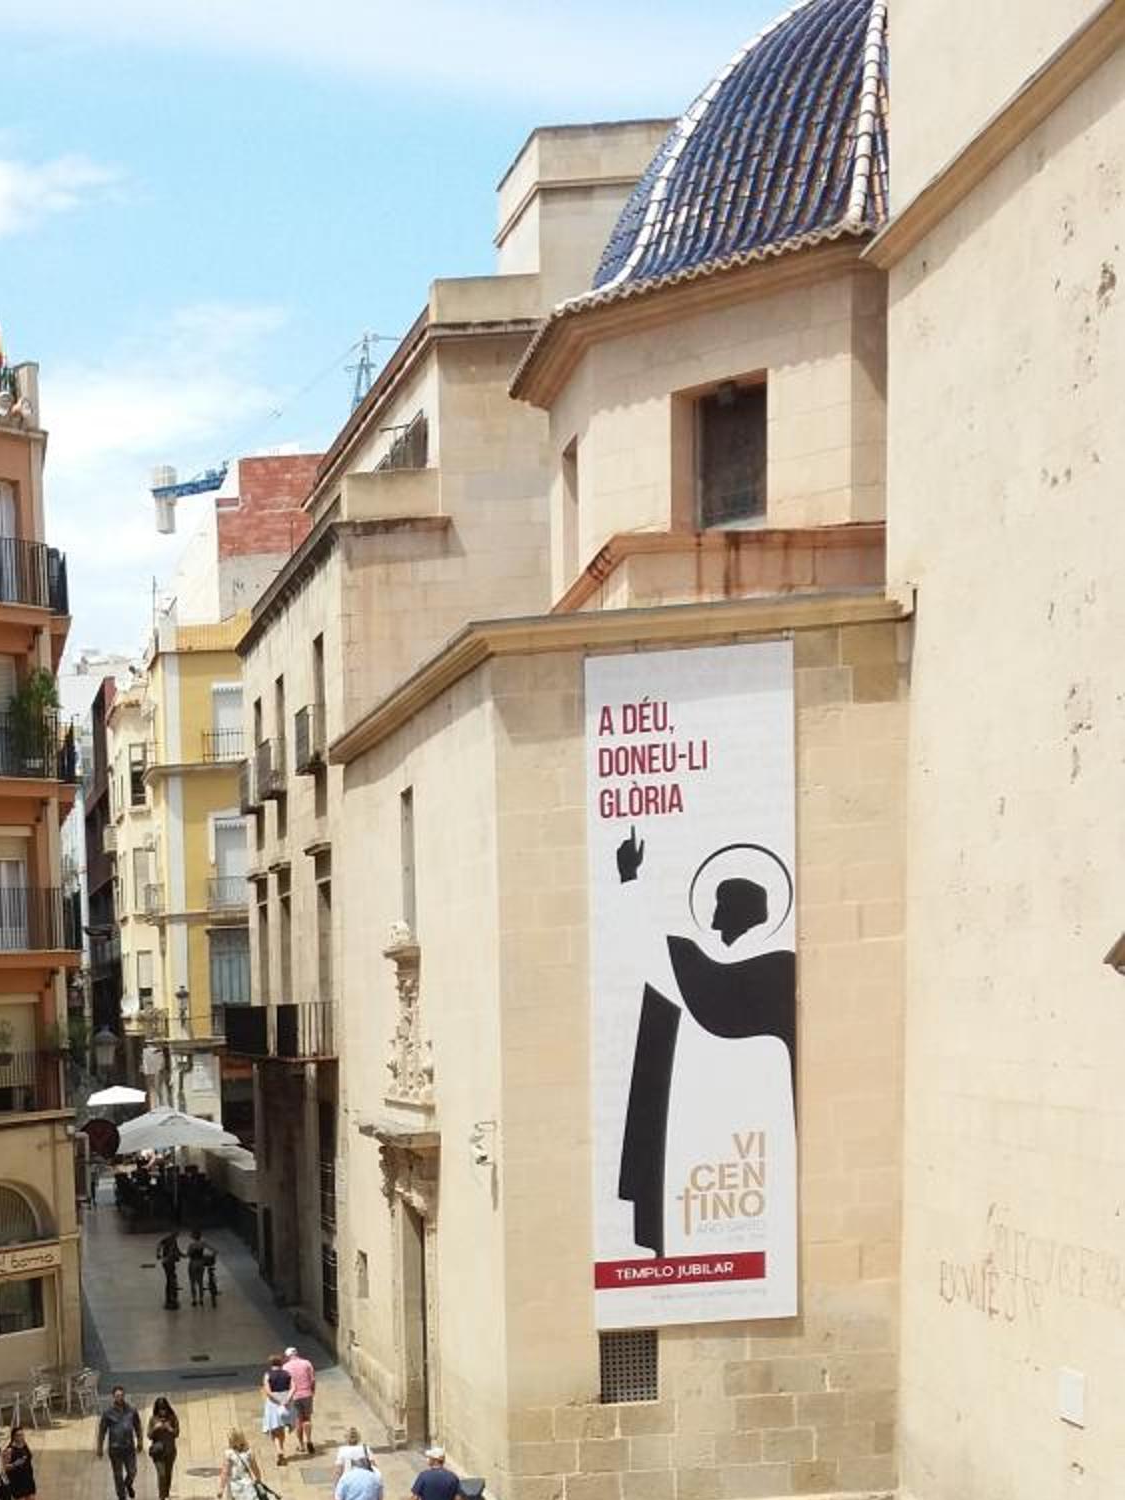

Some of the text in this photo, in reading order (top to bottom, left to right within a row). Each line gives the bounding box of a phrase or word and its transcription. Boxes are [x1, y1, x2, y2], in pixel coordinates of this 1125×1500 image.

[599, 696, 675, 736] A DÉU,
[598, 739, 708, 778] DONEU-LI
[599, 781, 683, 819] GLÒRIA
[732, 1131, 765, 1159] VI
[690, 1162, 765, 1191] CEN
[615, 1261, 735, 1281] TEMPLO JUBILAR
